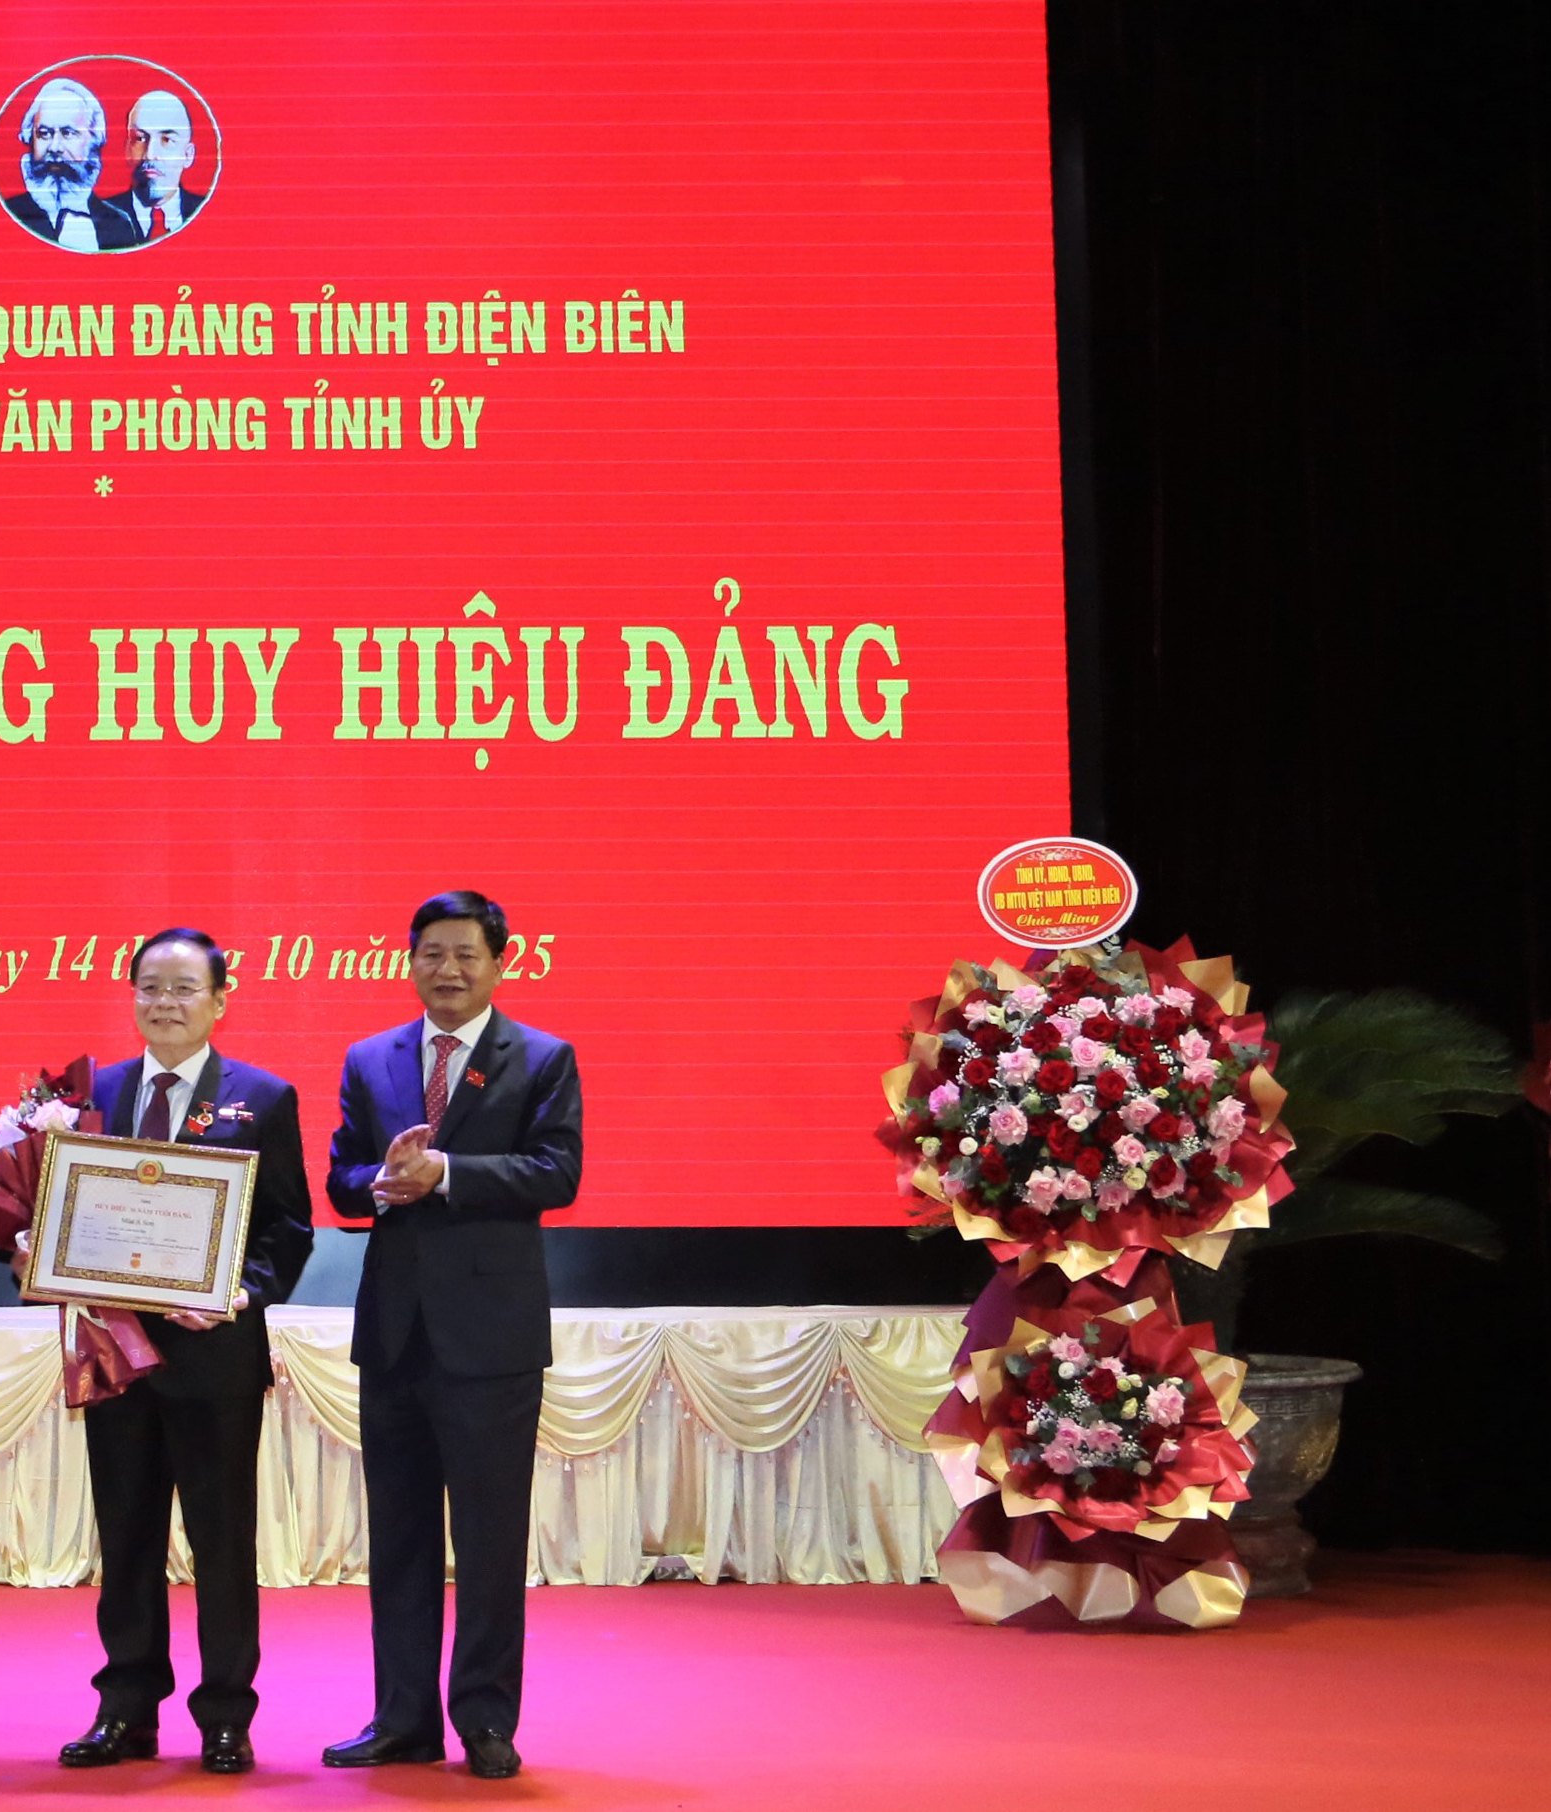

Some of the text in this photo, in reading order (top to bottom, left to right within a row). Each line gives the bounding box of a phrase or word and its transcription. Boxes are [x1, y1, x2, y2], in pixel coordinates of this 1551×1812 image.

[131, 285, 273, 356] ĐẢNG
[290, 284, 408, 355] TỈNH
[424, 290, 546, 366] ĐIỆN
[565, 289, 685, 353] BIÊN
[91, 385, 266, 452] PHÒNG
[283, 379, 401, 450] TỈNH
[420, 378, 484, 450] ỦY
[90, 628, 300, 743] HUY
[333, 591, 585, 770] HIỆU
[621, 577, 909, 740] ĐẢNG
[1006, 892, 1027, 910] MTTQ
[1027, 888, 1043, 912] VIỆT
[1044, 890, 1064, 907] NAM
[1063, 884, 1082, 907] TỈNH
[1101, 884, 1121, 905] BIÊN
[1015, 862, 1034, 884] TỈNH
[45, 935, 97, 981] 14
[261, 935, 314, 981] 10
[501, 934, 555, 980] 25
